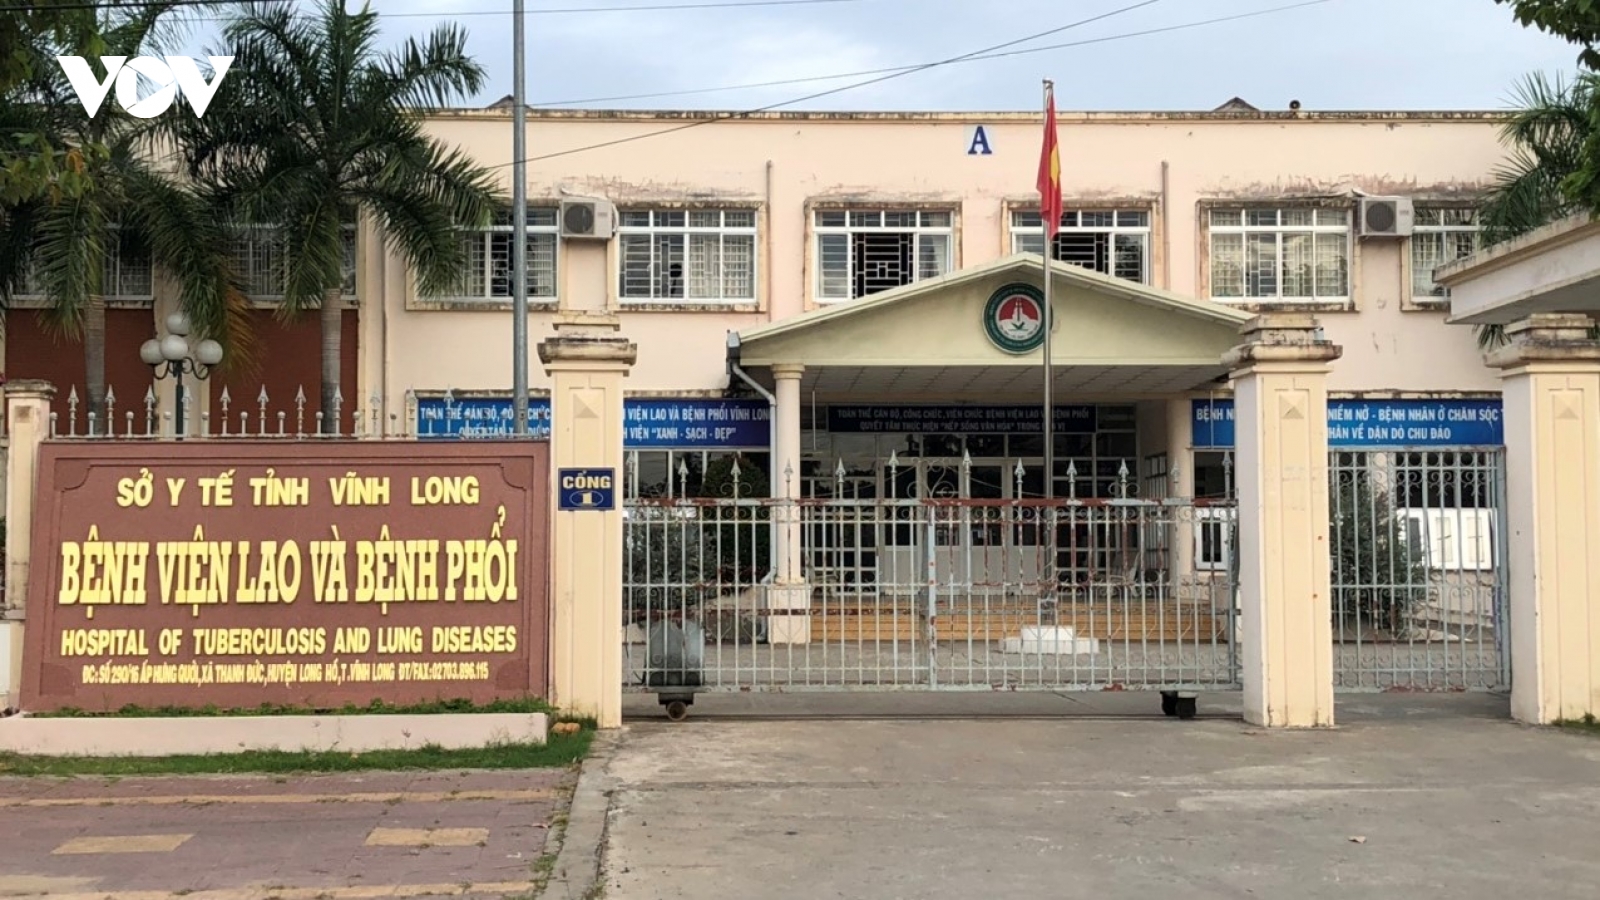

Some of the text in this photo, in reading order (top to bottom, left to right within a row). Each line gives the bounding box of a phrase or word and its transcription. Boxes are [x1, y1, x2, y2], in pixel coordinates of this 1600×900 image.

[967, 125, 992, 155] A
[628, 405, 648, 424] VIỆN
[651, 408, 667, 420] LAO
[668, 404, 680, 420] VÀ
[682, 406, 706, 422] BỆNH
[752, 408, 771, 421] LON
[1378, 406, 1405, 422] BỆNH
[1408, 406, 1435, 421] NHÂN
[630, 424, 649, 442] VIỆN
[686, 427, 707, 442] SẠCH
[1391, 425, 1405, 439] DÒ
[1407, 428, 1428, 439] CHU
[1430, 425, 1451, 439] ĐÁO
[116, 467, 480, 507] SỞ Y TẾ TỈNH VĨNH LONG
[562, 469, 612, 489] CỔNG
[59, 505, 518, 619] BỆNH VIỆN LAO VÀ BỆNH PHỔI
[61, 625, 517, 656] HOSPITAL OF TUBERCULOSIS AND LUNG DISEASES
[215, 664, 245, 684] THANH
[299, 663, 323, 682] LONG
[372, 662, 395, 681] LONG
